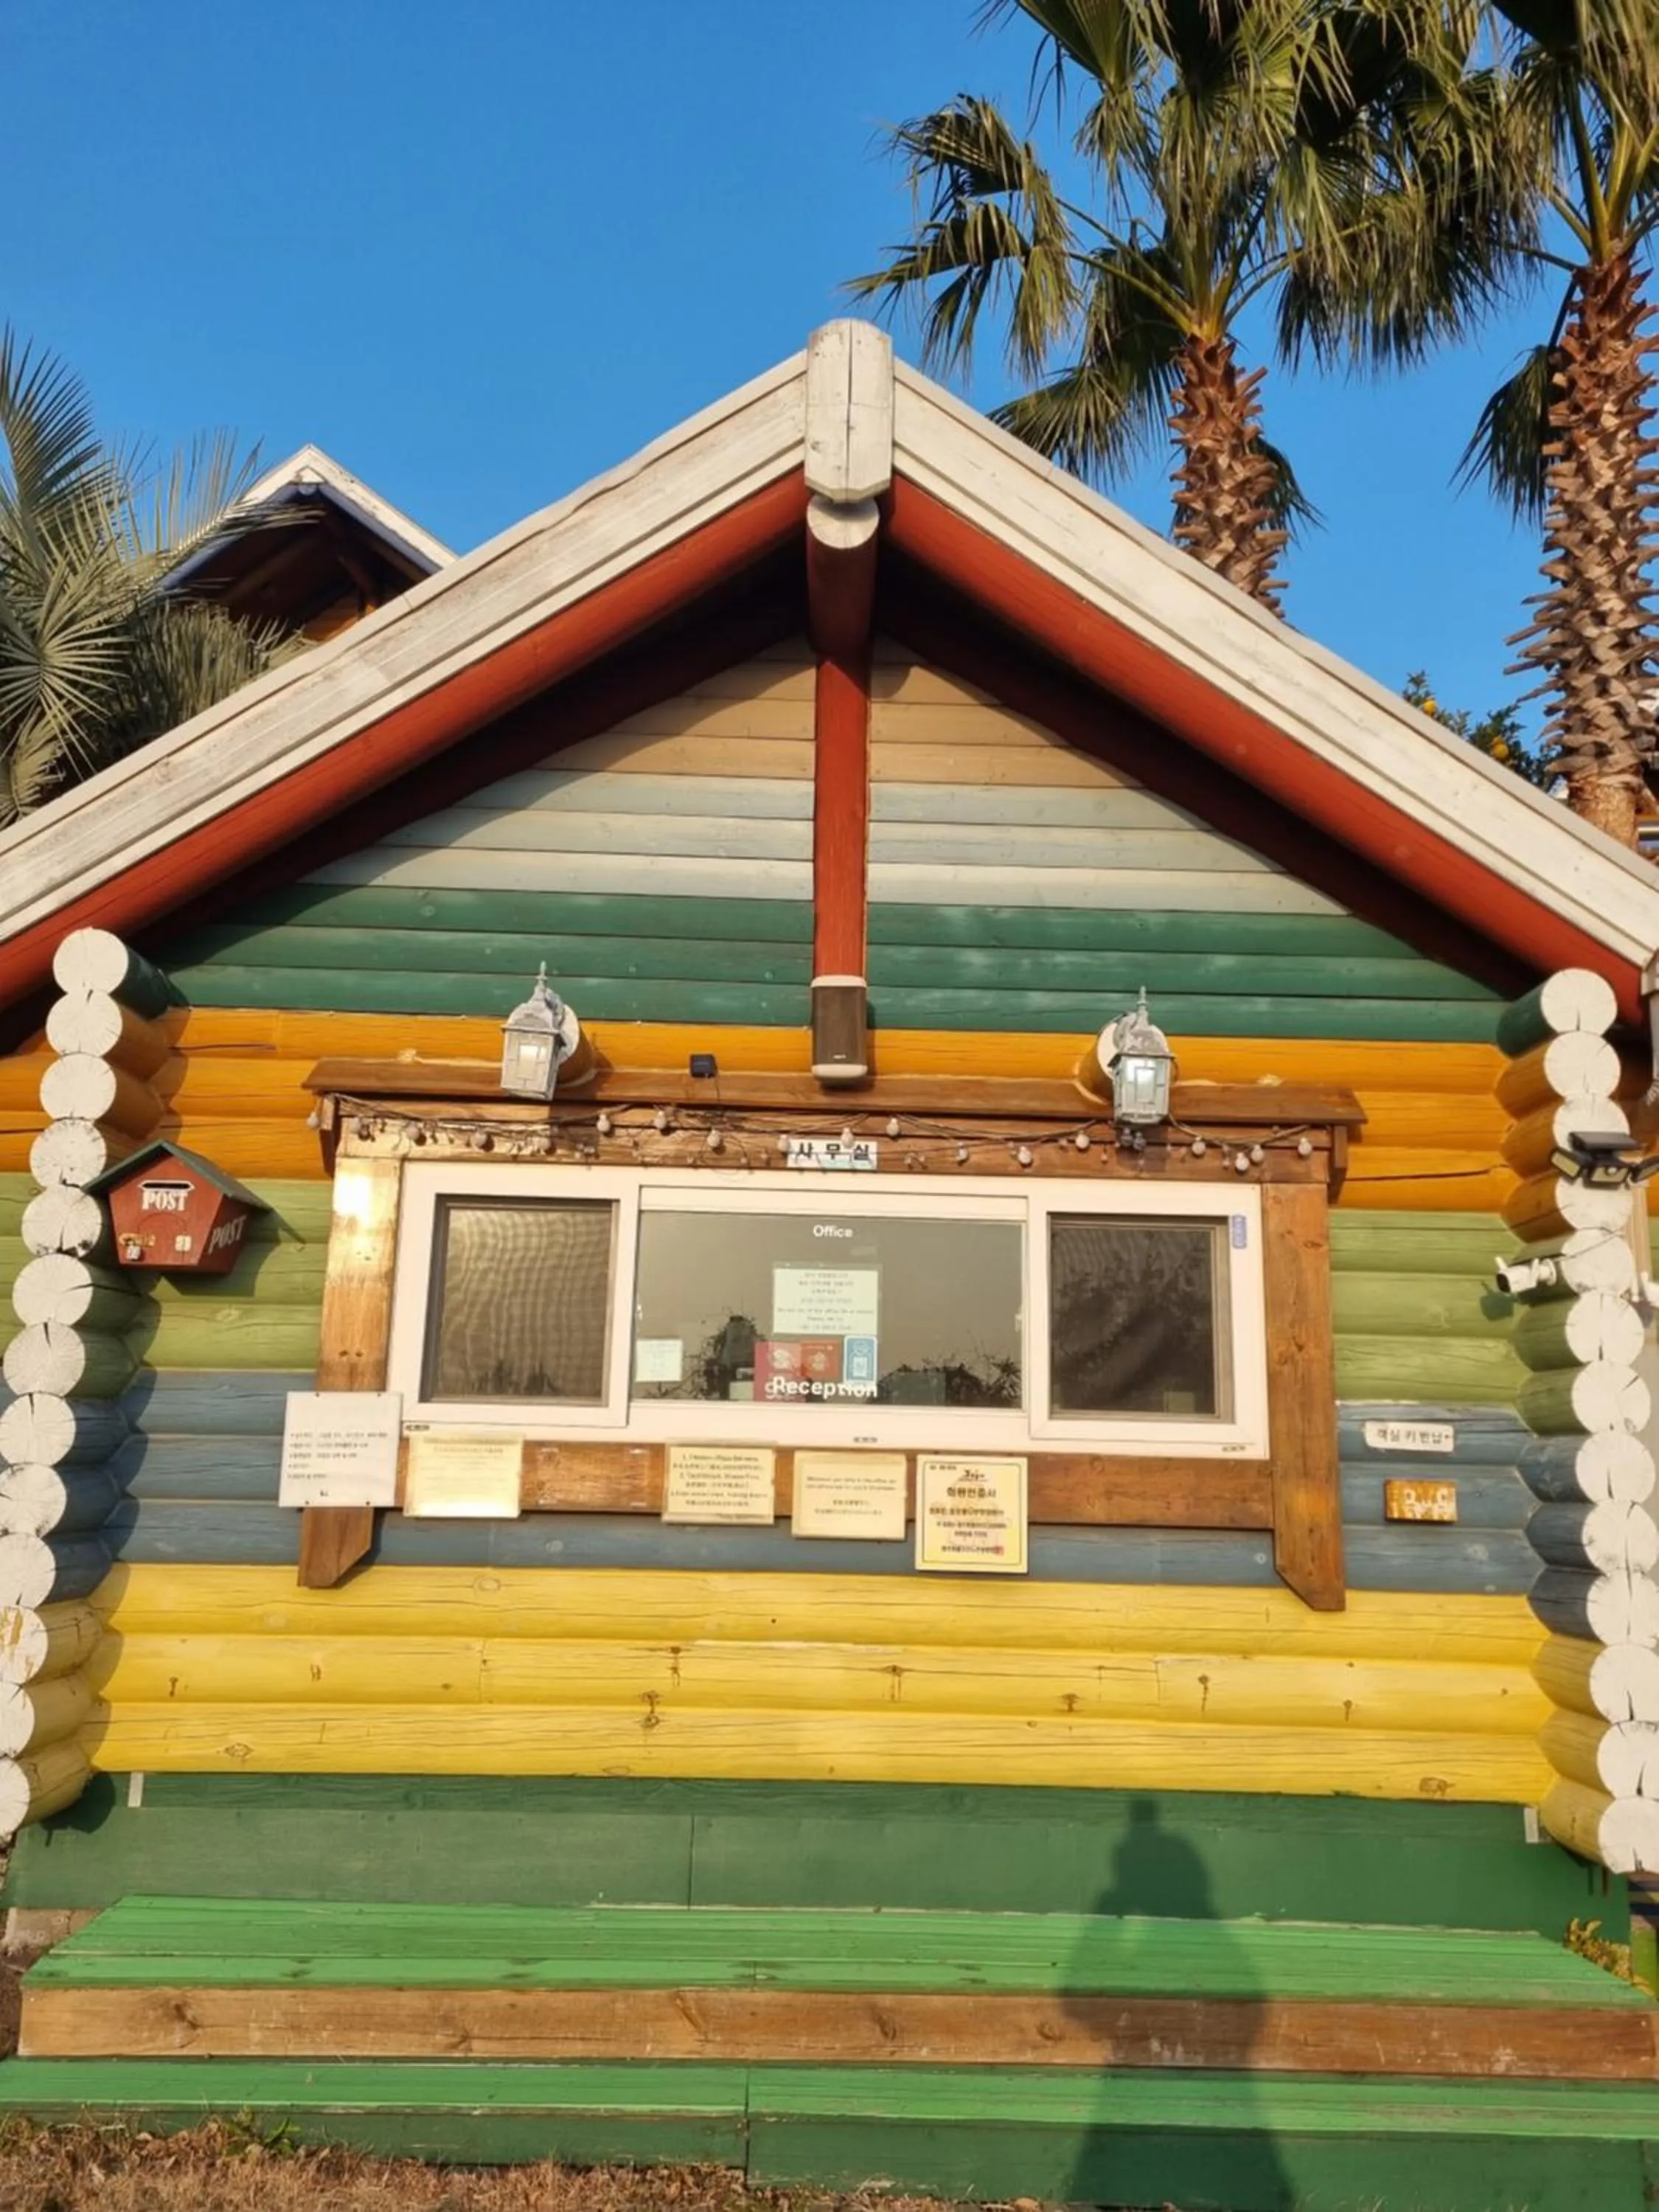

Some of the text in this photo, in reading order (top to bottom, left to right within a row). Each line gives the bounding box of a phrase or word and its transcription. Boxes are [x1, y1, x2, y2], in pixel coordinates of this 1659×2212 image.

[799, 1142, 869, 1161] 사무실
[142, 1191, 188, 1211] POST
[208, 1215, 247, 1256] POST
[813, 1224, 853, 1238] Office
[772, 1376, 878, 1399] Reception
